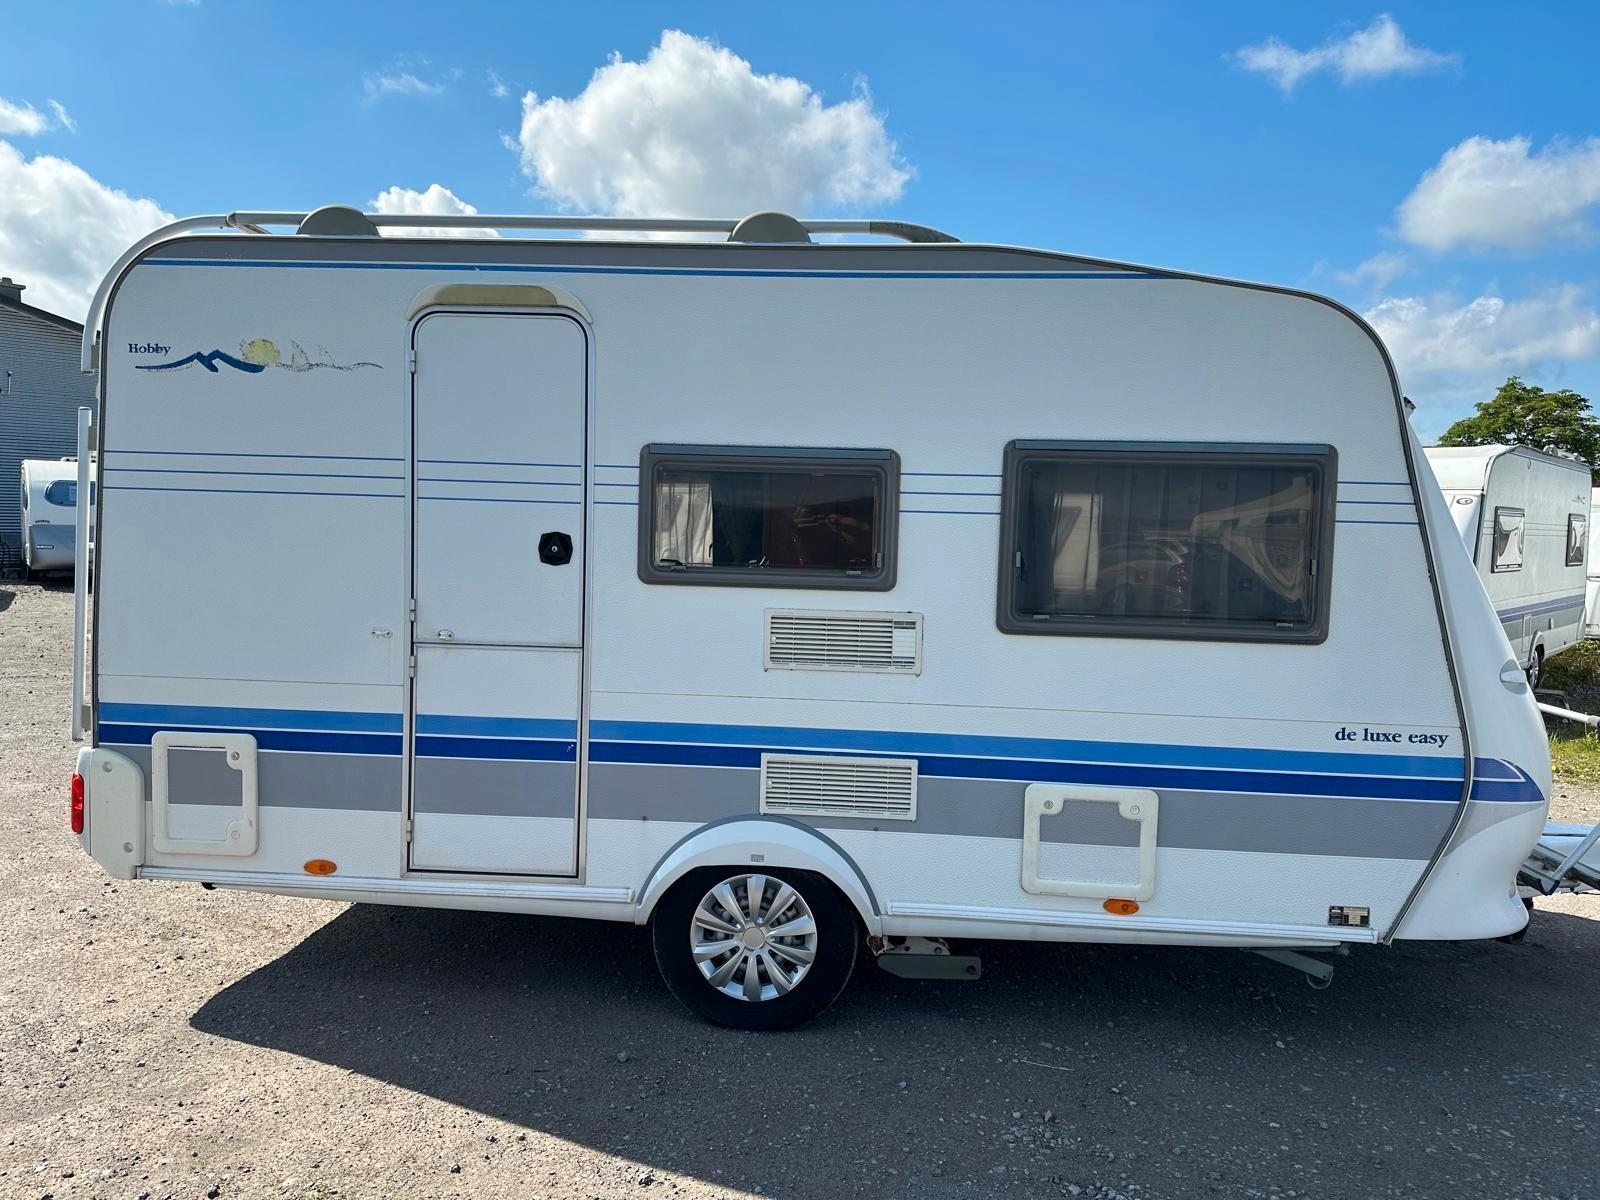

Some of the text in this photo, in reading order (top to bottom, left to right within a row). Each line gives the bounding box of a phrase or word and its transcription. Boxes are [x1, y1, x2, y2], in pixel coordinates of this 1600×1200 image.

[128, 343, 171, 356] Hobby
[1334, 727, 1449, 748] de luxe easy
